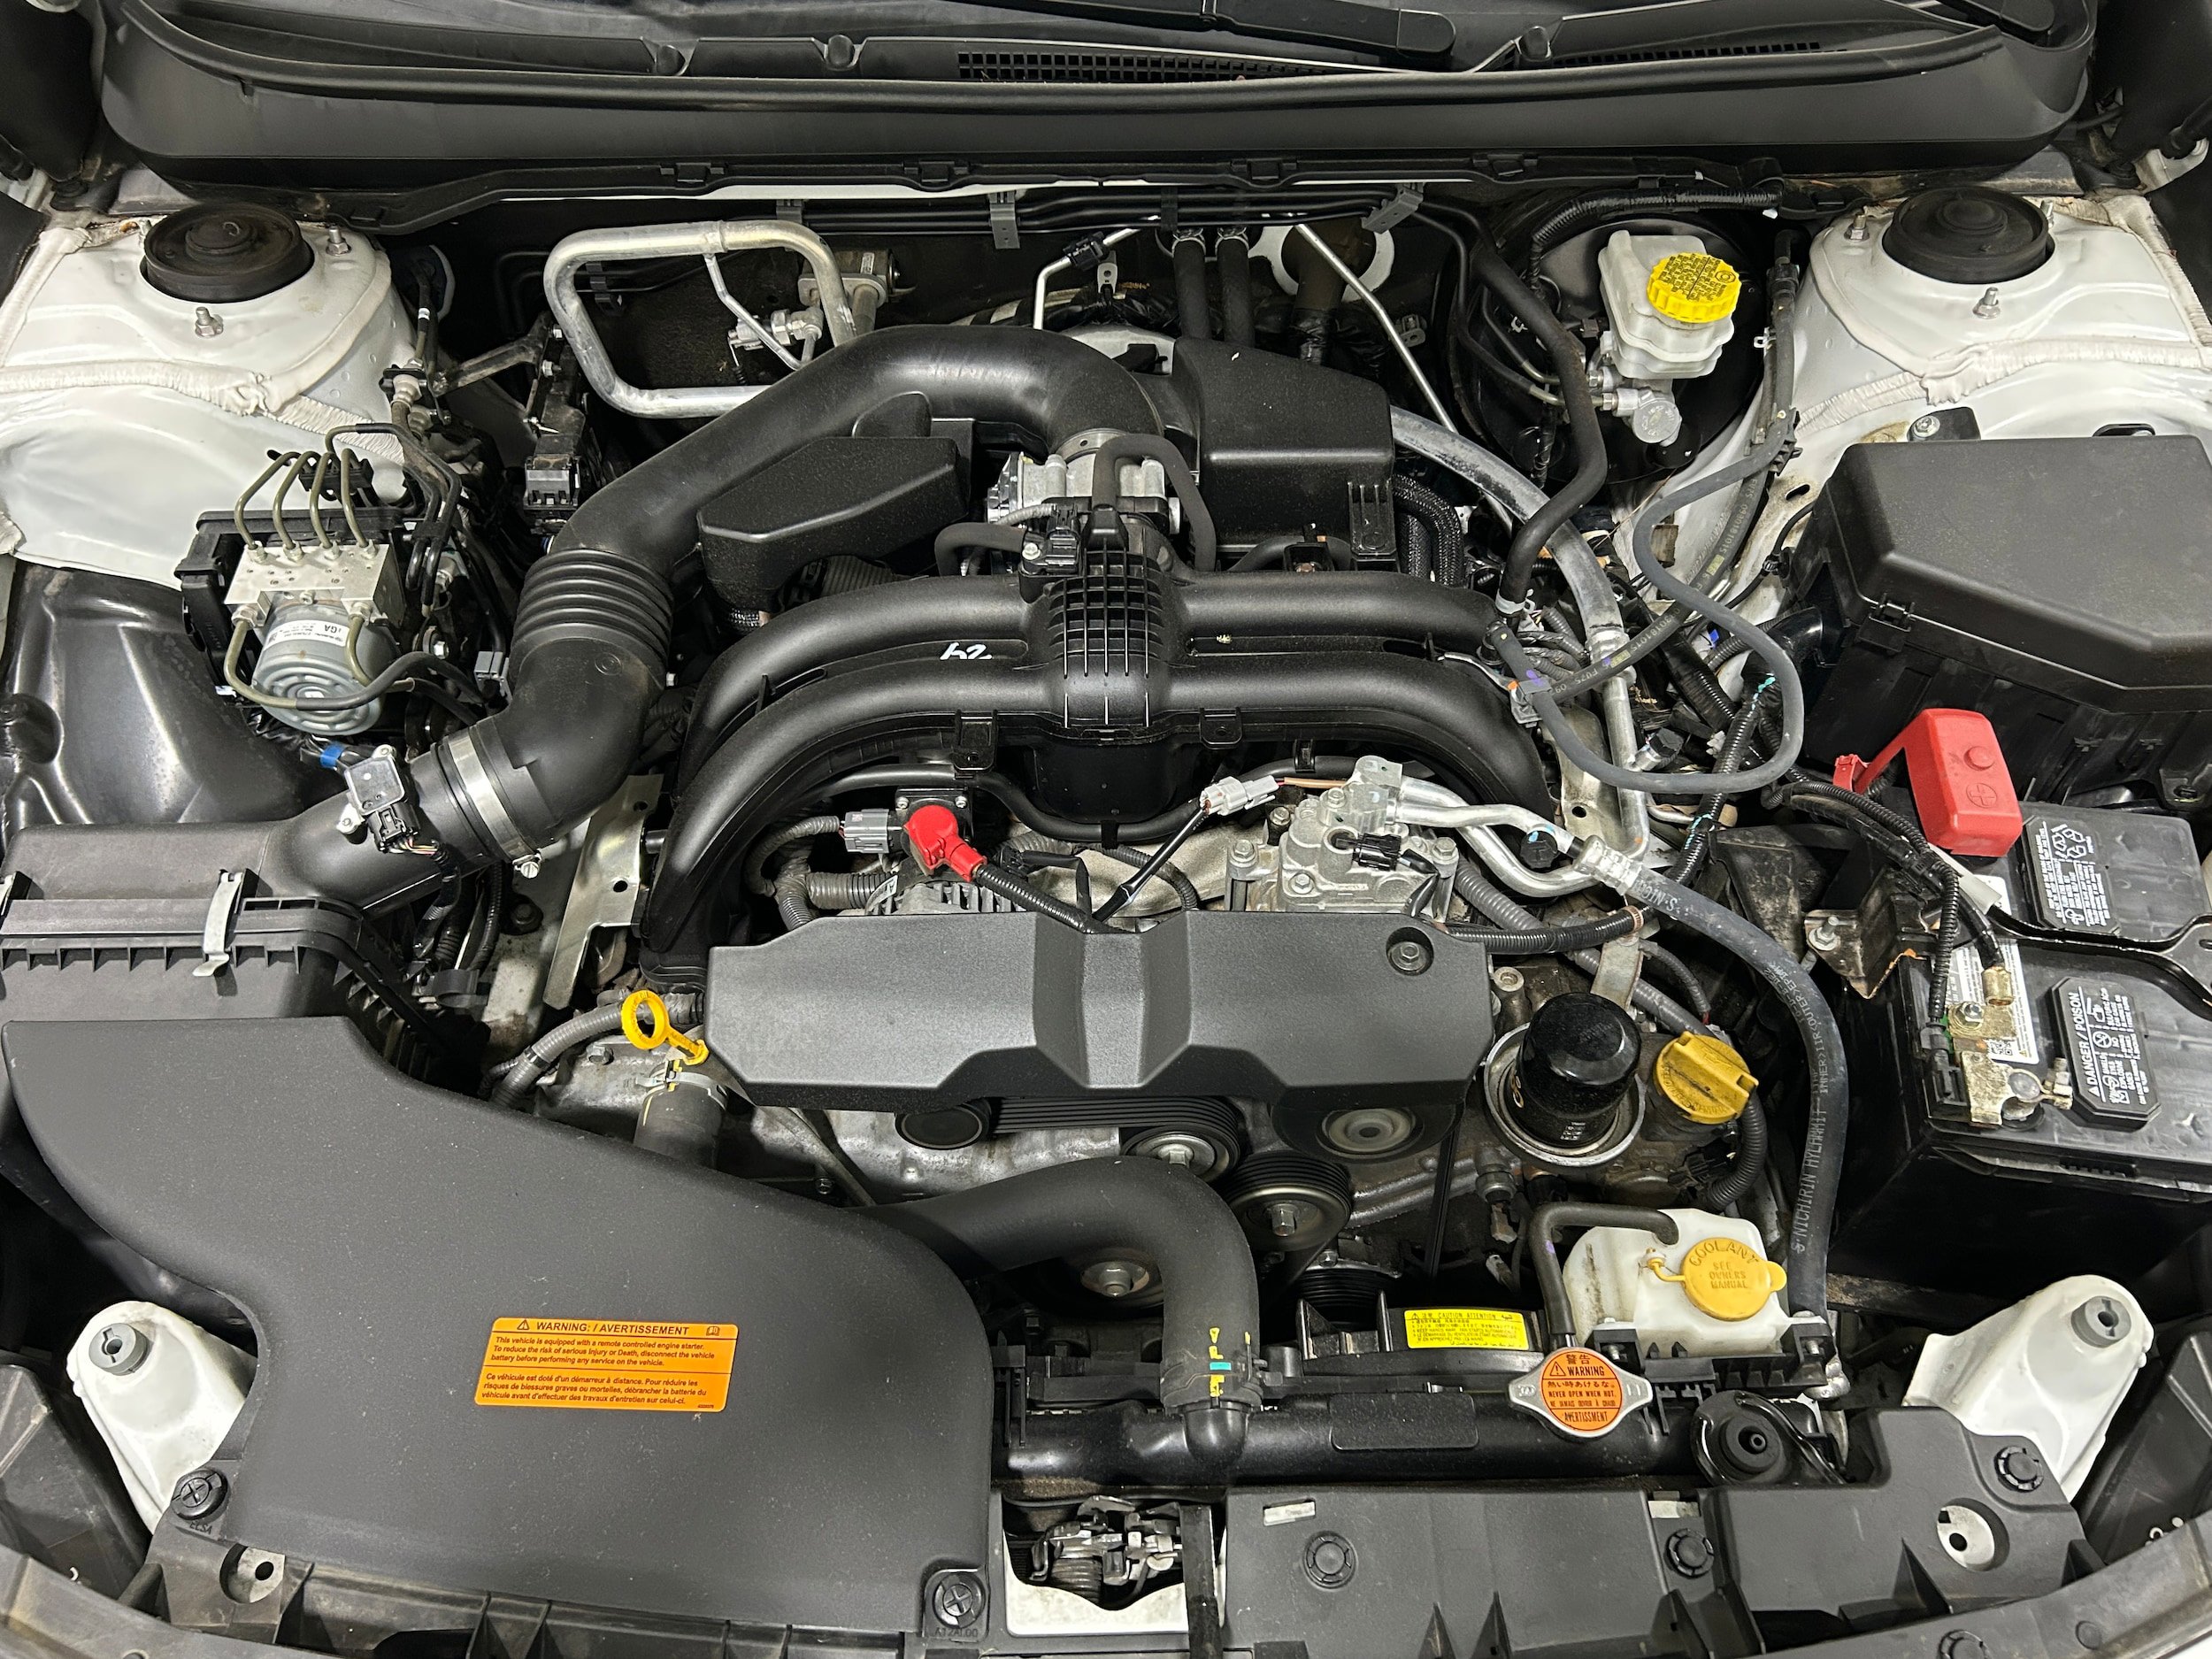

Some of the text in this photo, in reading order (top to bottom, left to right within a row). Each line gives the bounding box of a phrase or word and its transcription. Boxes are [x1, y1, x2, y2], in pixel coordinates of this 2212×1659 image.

[2068, 991, 2086, 1032] POISON
[2078, 1041, 2098, 1086] DANGER
[1689, 1240, 1759, 1266] COOLANT
[1710, 1280, 1749, 1289] MANUAL
[536, 1322, 591, 1332] WARNING:
[599, 1324, 689, 1335] AVERTISSEMENT
[1565, 1355, 1590, 1365] 警告
[1567, 1366, 1605, 1377] WARNING
